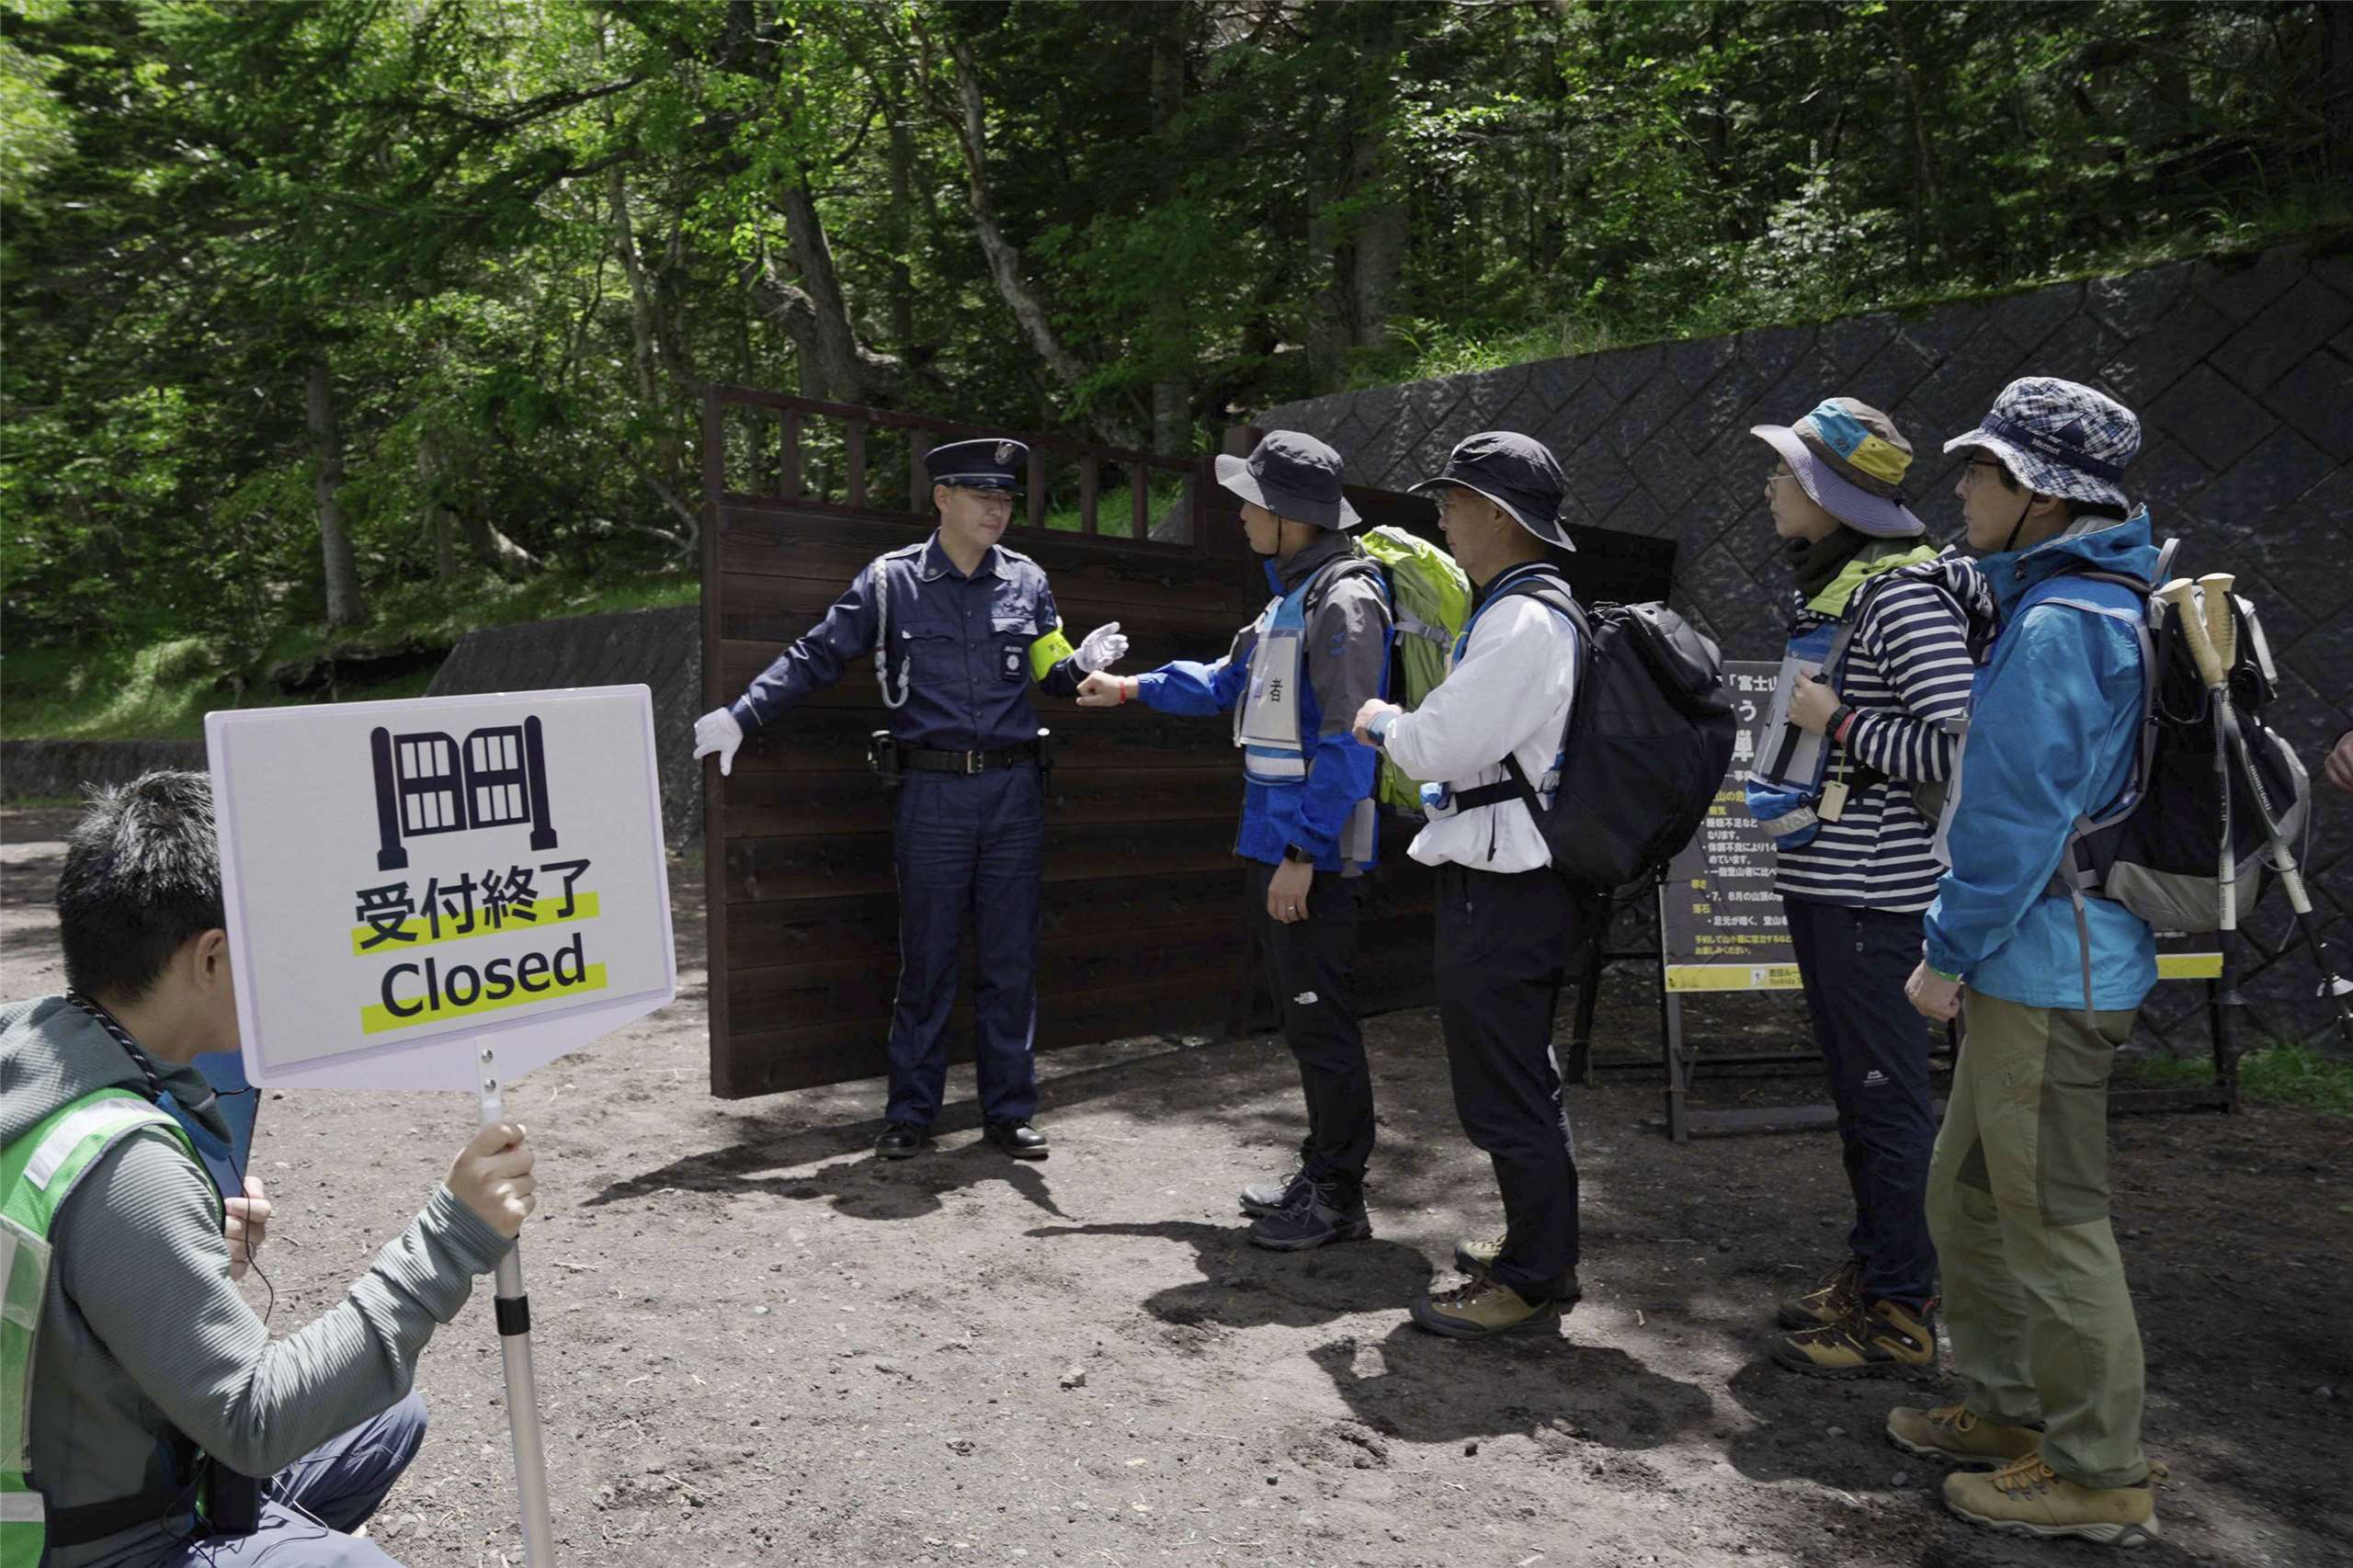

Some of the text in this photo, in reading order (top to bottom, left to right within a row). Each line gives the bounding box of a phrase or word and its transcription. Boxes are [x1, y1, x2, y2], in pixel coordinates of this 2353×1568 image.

[356, 858, 591, 950] 受付終了
[381, 932, 586, 1017] Closed
